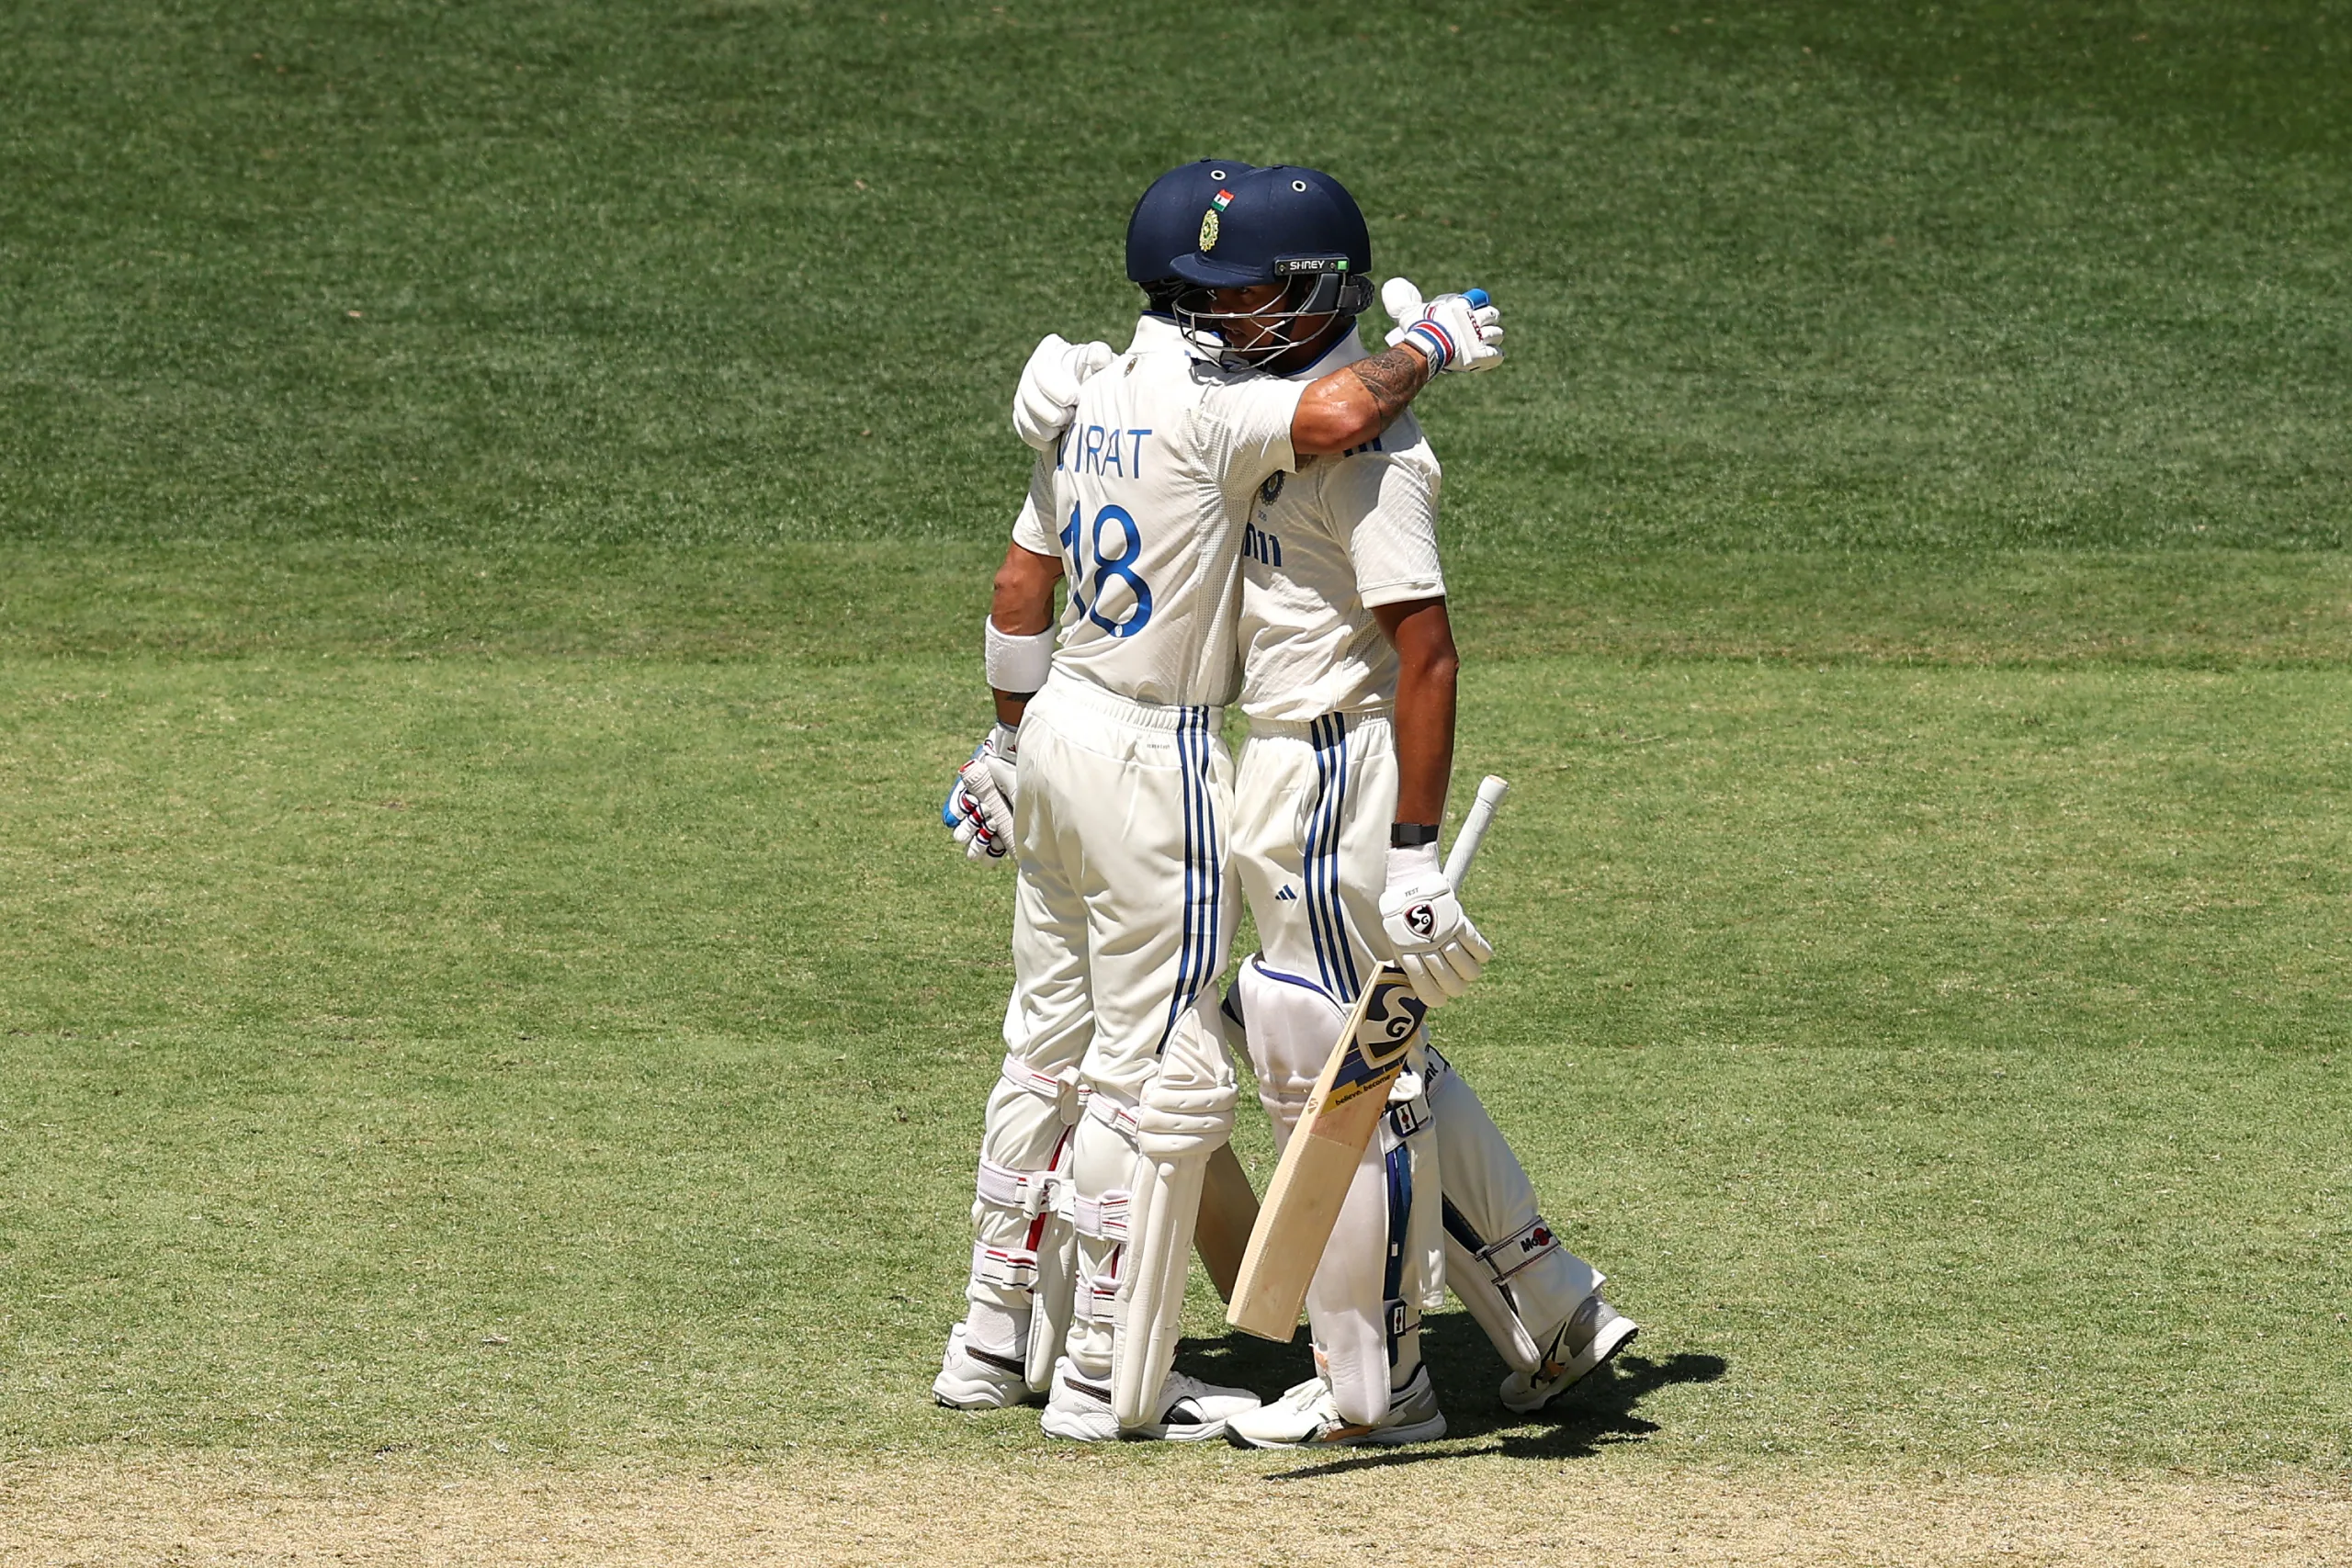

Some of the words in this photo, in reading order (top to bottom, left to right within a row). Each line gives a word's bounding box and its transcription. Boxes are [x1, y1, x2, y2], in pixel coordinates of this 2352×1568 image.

[1289, 260, 1325, 270] SHREY
[1059, 500, 1152, 637] 18
[1405, 886, 1419, 897] TEST
[1411, 905, 1431, 933] SG
[1356, 986, 1418, 1044] SG
[1363, 1075, 1391, 1091] become
